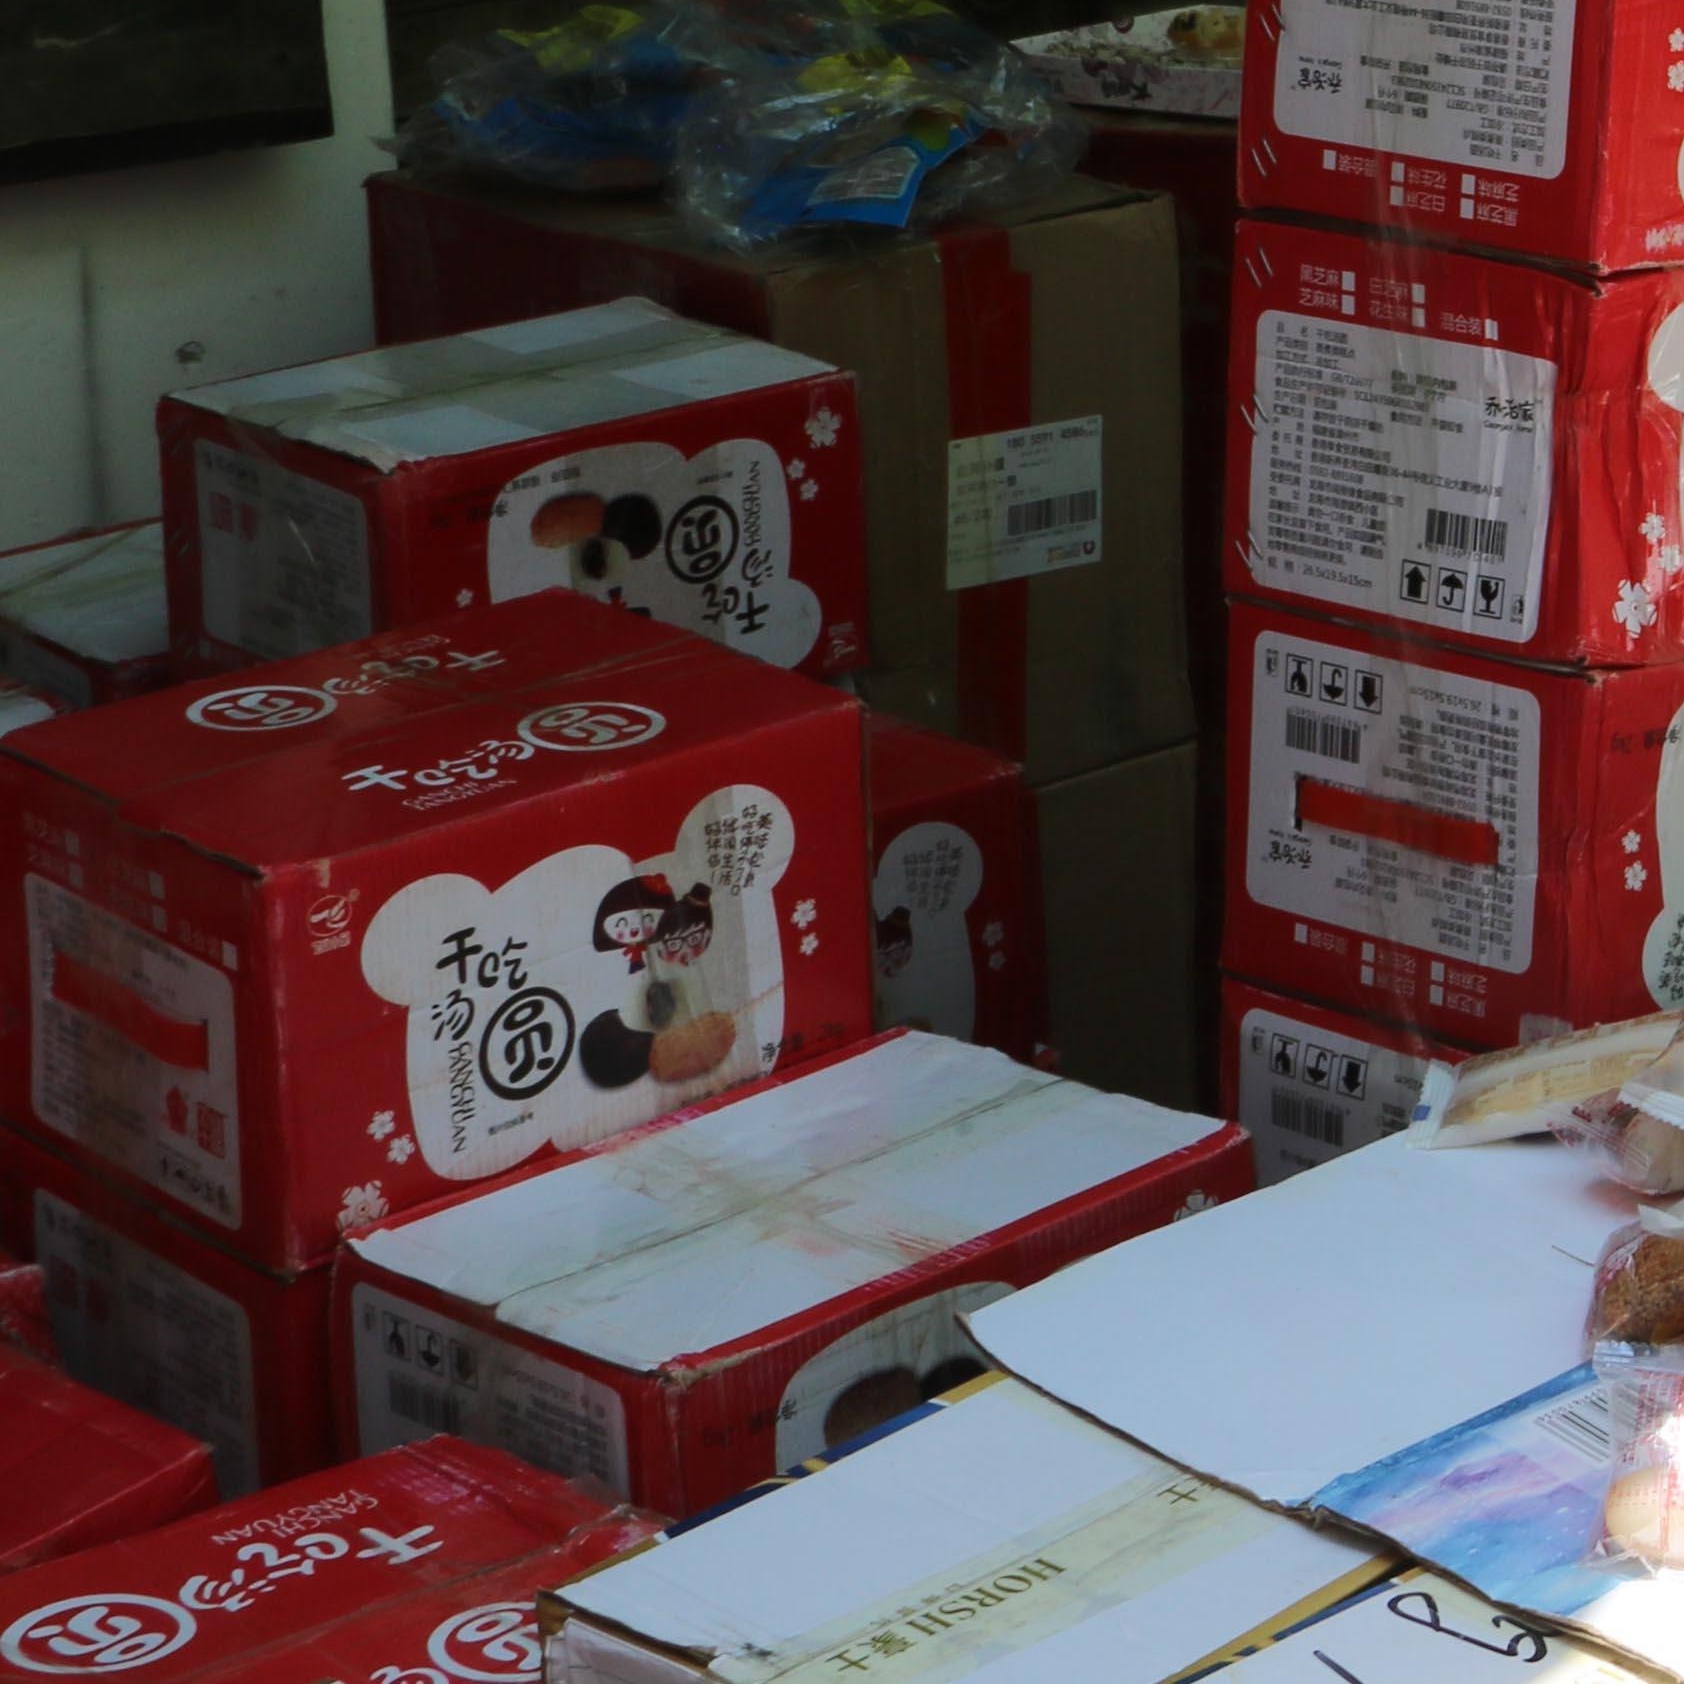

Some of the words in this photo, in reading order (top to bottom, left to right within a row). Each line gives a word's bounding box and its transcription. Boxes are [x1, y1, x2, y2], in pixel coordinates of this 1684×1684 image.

[1478, 178, 1520, 202] 芝麻味
[1476, 202, 1519, 228] 黑芝麻
[1299, 288, 1338, 310] 芝麻味
[906, 1557, 1066, 1638] HORSH
[825, 1629, 919, 1674] 豪士
